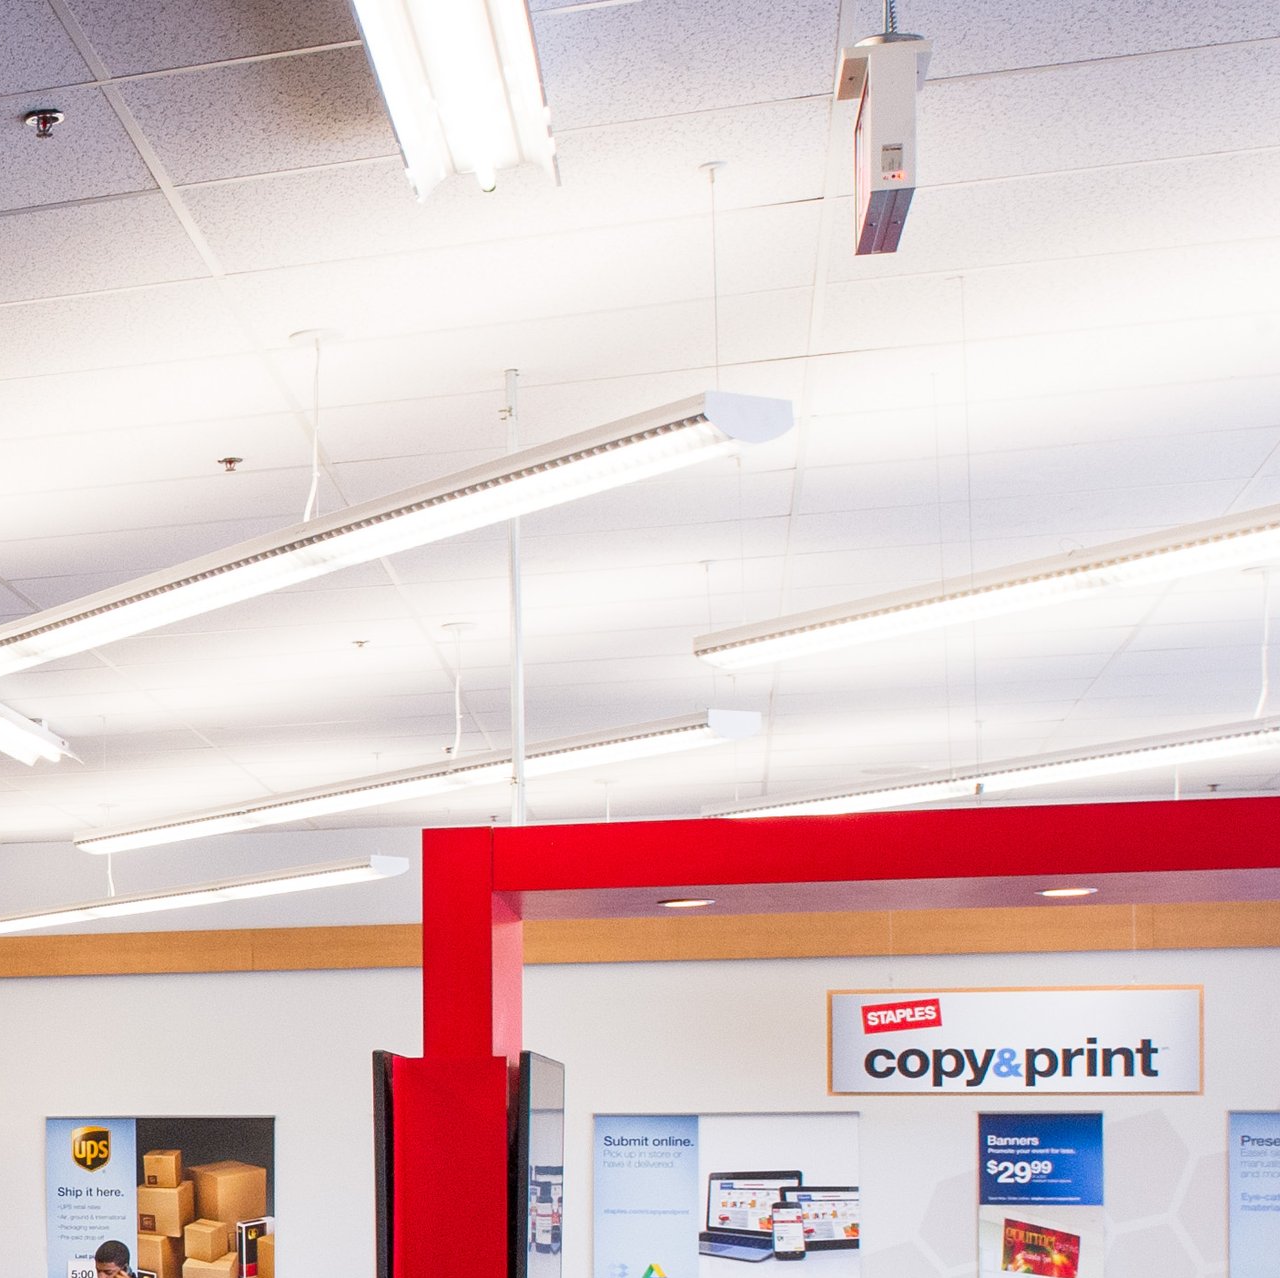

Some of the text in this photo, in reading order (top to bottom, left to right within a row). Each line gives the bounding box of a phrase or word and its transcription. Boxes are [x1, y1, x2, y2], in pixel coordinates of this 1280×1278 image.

[866, 1005, 937, 1026] STAPLES
[864, 1037, 1159, 1088] copy&print
[603, 1135, 694, 1148] Submit online.
[987, 1135, 1039, 1146] Banners
[74, 1140, 109, 1166] ups
[603, 1149, 672, 1160] Pick up store
[603, 1159, 624, 1168] have
[57, 1186, 125, 1198] Ship it here.
[1005, 1226, 1056, 1249] gourmet
[71, 1269, 94, 1278] 5:00
